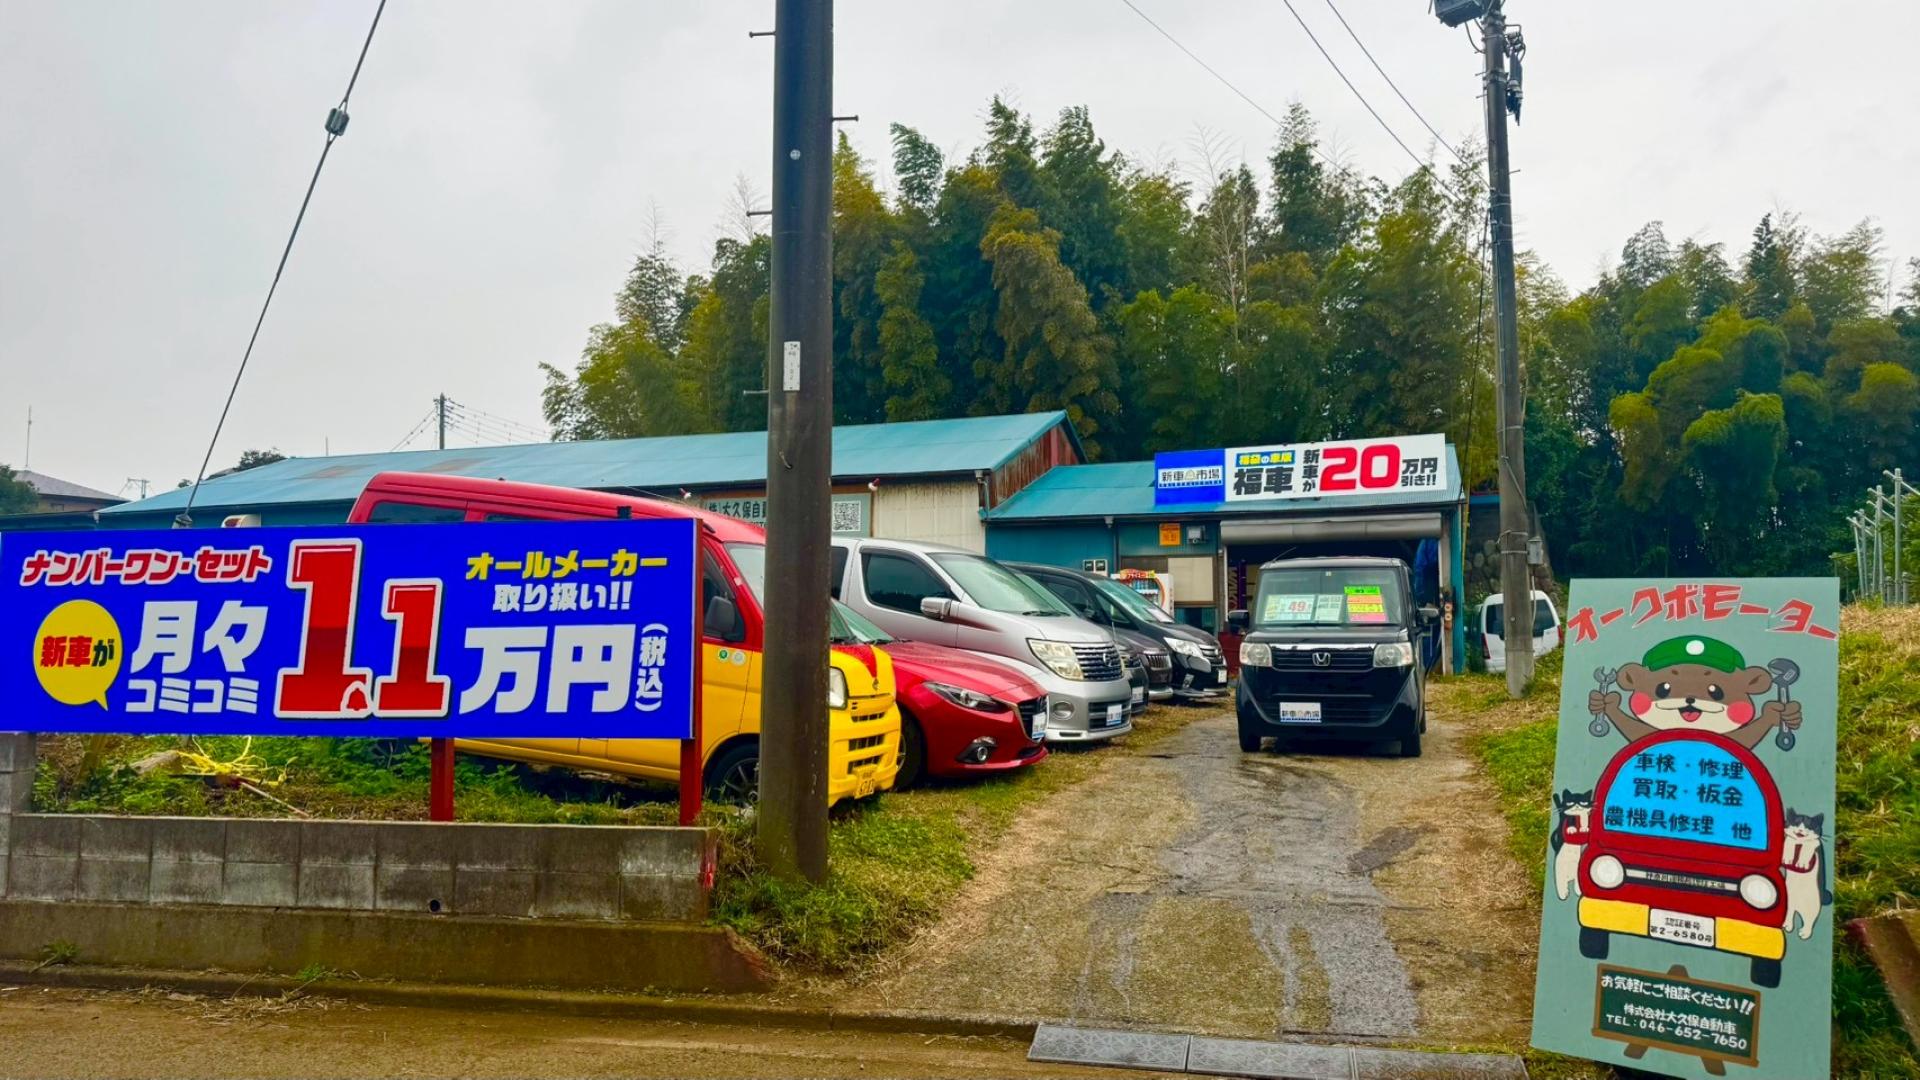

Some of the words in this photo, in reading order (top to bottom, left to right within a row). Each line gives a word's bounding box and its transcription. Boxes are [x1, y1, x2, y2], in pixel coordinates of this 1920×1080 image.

[1233, 467, 1294, 495] 福車
[1302, 449, 1320, 492] 新車が
[1319, 444, 1400, 491] 20
[1402, 457, 1438, 474] 万円
[466, 549, 668, 580] オールメーカー
[1567, 584, 1838, 645] オークボモーター
[42, 634, 115, 668] 新車が
[131, 600, 268, 674] 月々
[459, 624, 636, 714] 万円
[126, 677, 260, 714] コミコミ
[1604, 805, 1714, 835] 農機具修理
[1731, 821, 1752, 840] 他
[1623, 1003, 1737, 1034] 株式会社大久保自動車
